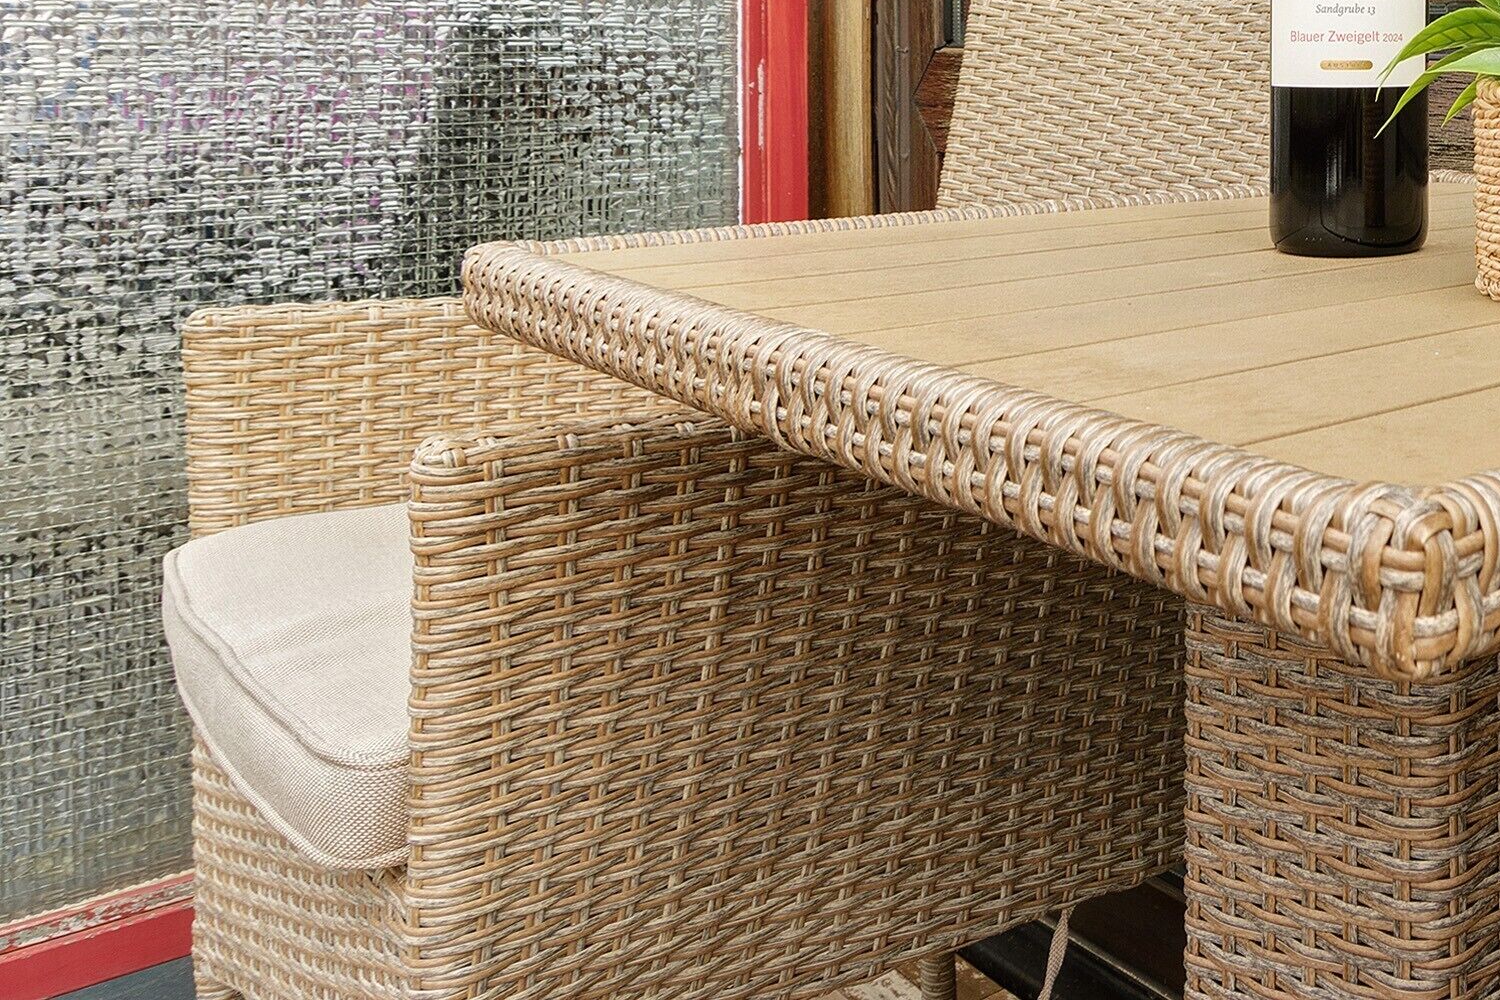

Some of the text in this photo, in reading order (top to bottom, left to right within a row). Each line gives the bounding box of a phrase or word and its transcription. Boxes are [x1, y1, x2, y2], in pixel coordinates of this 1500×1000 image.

[1315, 3, 1376, 17] Sandgrube 13
[1290, 30, 1403, 45] Blauer Zweigelt 2024
